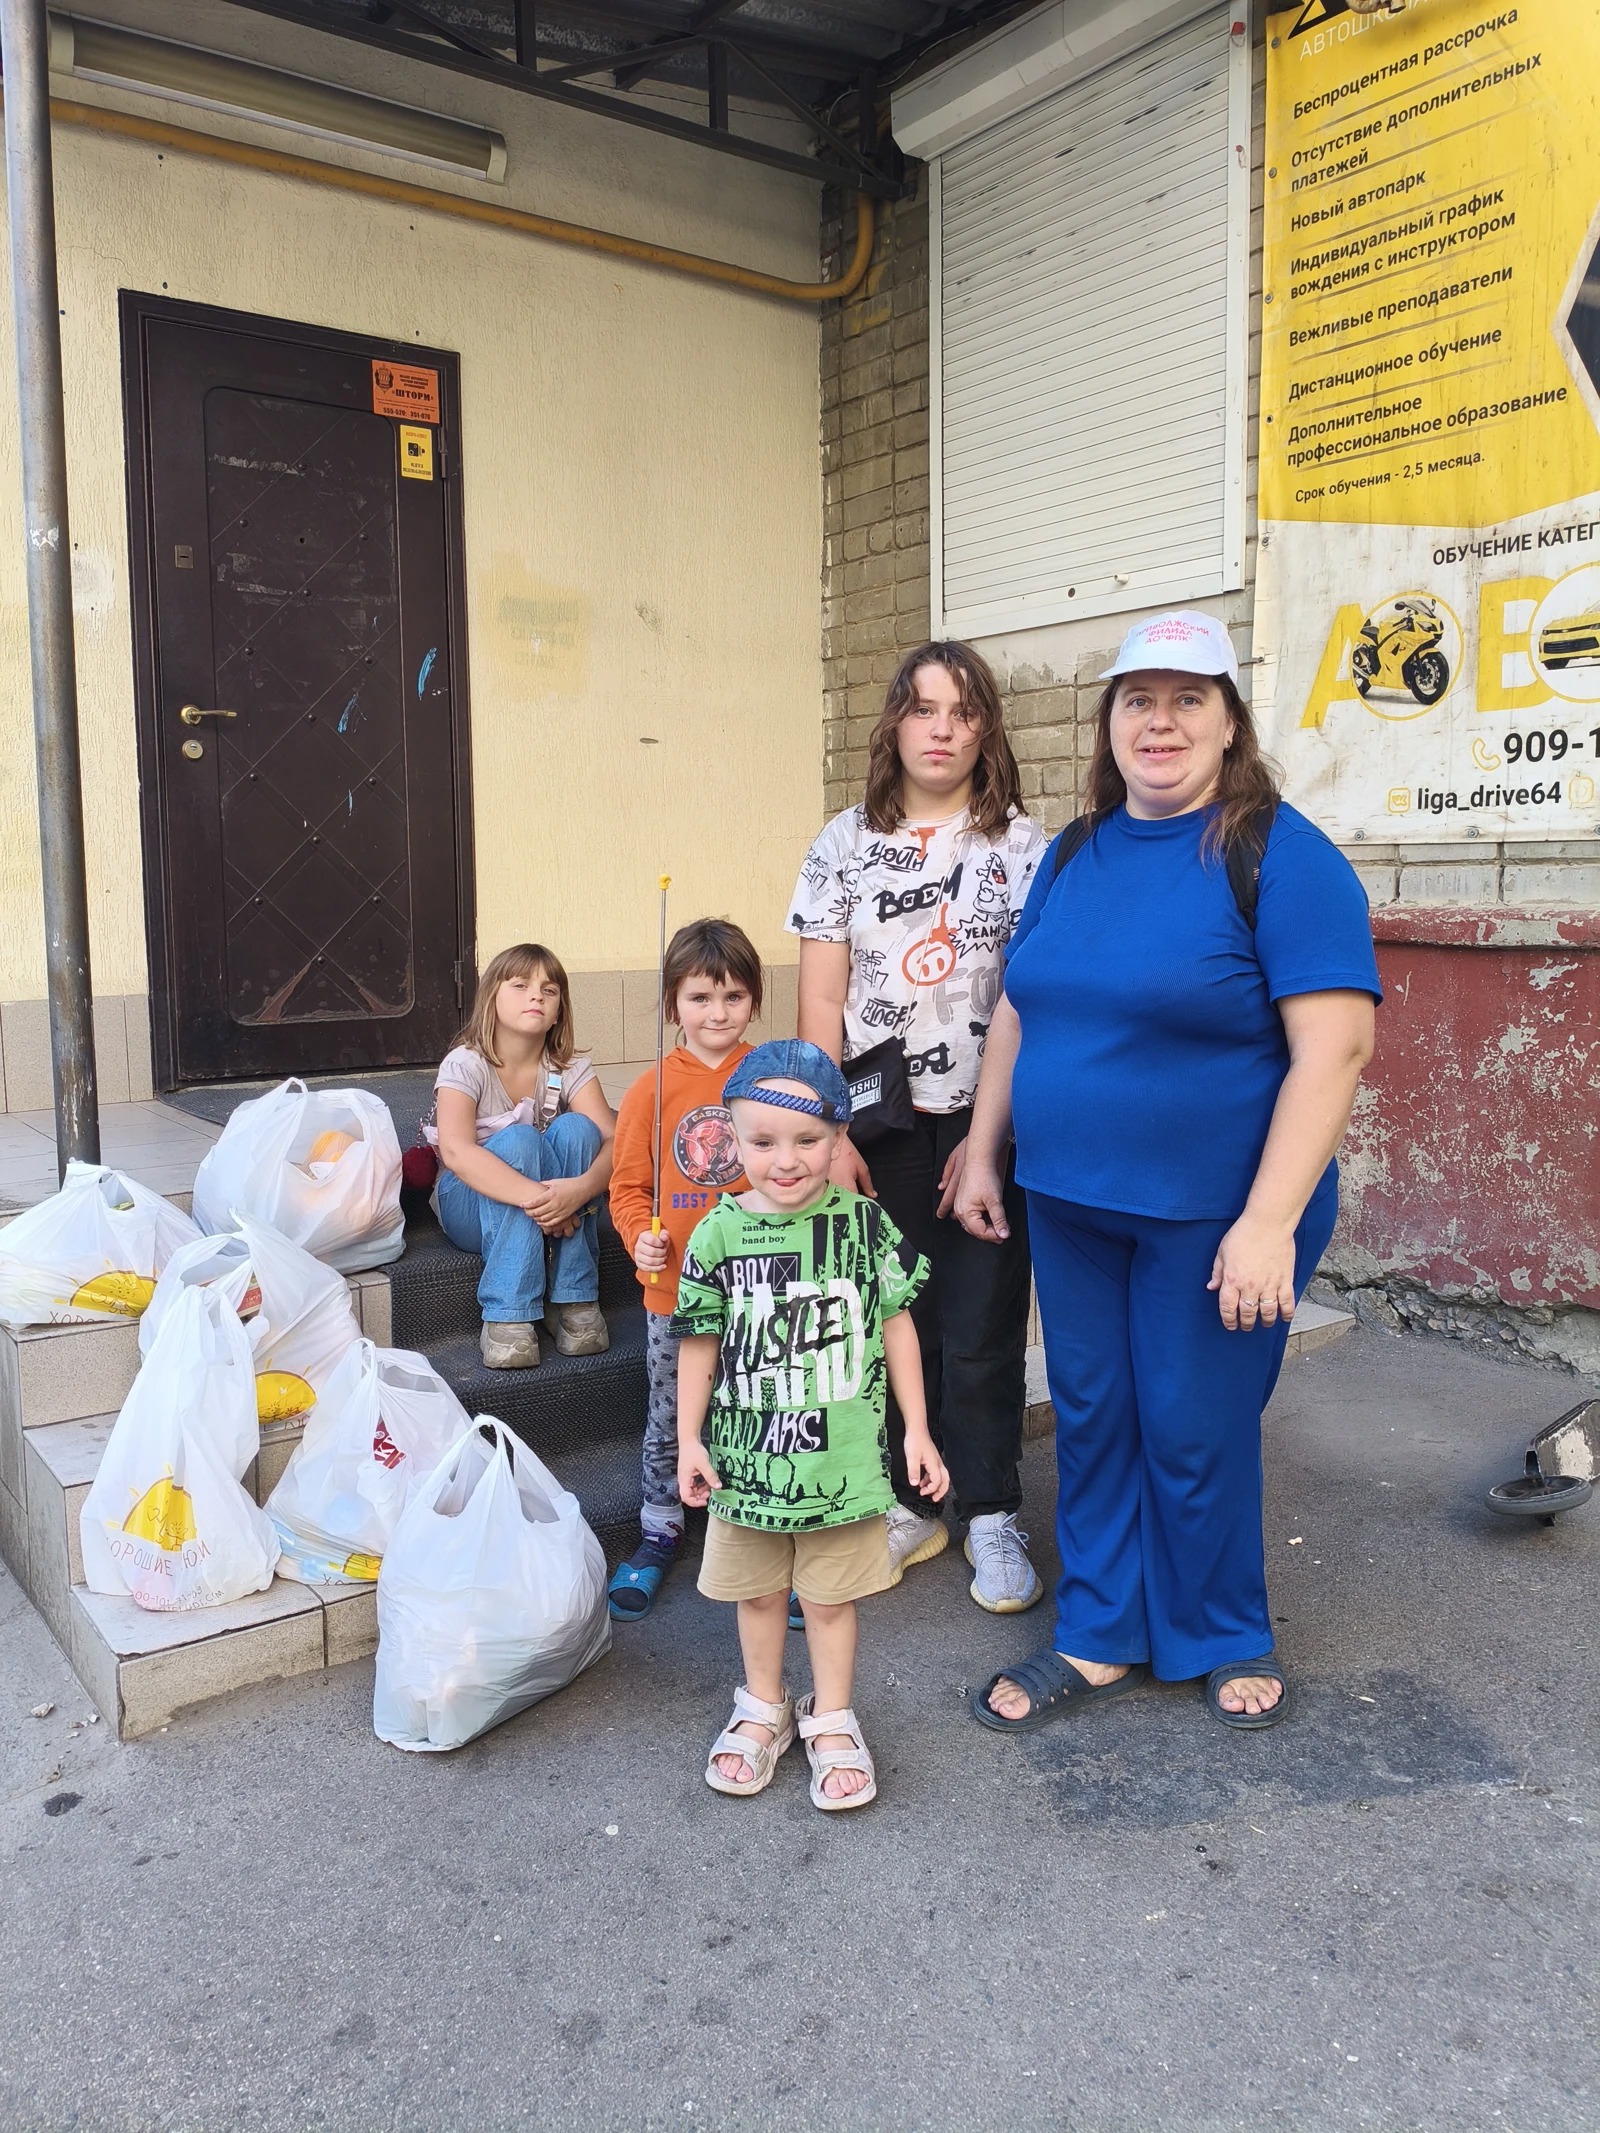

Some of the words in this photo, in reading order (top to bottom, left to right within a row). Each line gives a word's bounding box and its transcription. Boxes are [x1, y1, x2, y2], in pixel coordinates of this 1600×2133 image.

[1293, 53, 1418, 119] Беспроцентная
[1424, 9, 1518, 66] рассрочка
[1291, 120, 1382, 168] Отсутствие
[1386, 53, 1542, 132] дополнительных
[1291, 147, 1368, 192] платежей
[1291, 198, 1344, 232] Новый
[1348, 171, 1426, 211] автопарк
[1290, 212, 1434, 275] Индивидуальный
[1439, 189, 1504, 224] график
[1290, 261, 1370, 299] вождения
[1374, 258, 1383, 271] с
[1388, 212, 1516, 267] инструктором
[1289, 310, 1373, 347] Вежливые
[1377, 267, 1513, 319] преподаватели
[1289, 354, 1413, 402] Дистанционное
[1419, 328, 1502, 366] обучение
[1287, 417, 1442, 469] профессиональное
[1446, 386, 1567, 428] образование
[1288, 396, 1422, 446] Дополнительное
[1295, 487, 1325, 503] Срок
[1329, 472, 1391, 494] обучения
[1403, 462, 1423, 479] 2,5
[1428, 452, 1485, 473] месяца.
[1433, 533, 1532, 565] ОБУЧЕНИЕ
[1149, 628, 1192, 636] ФИЛИАЛ
[1417, 781, 1562, 815] liga_drive64
[872, 862, 963, 923] BOOM
[965, 924, 1000, 939] YEAH!
[672, 1193, 708, 1208] BEST
[742, 1236, 765, 1245] band
[769, 1236, 786, 1244] boy
[106, 1537, 173, 1577] ОРОШИЕ
